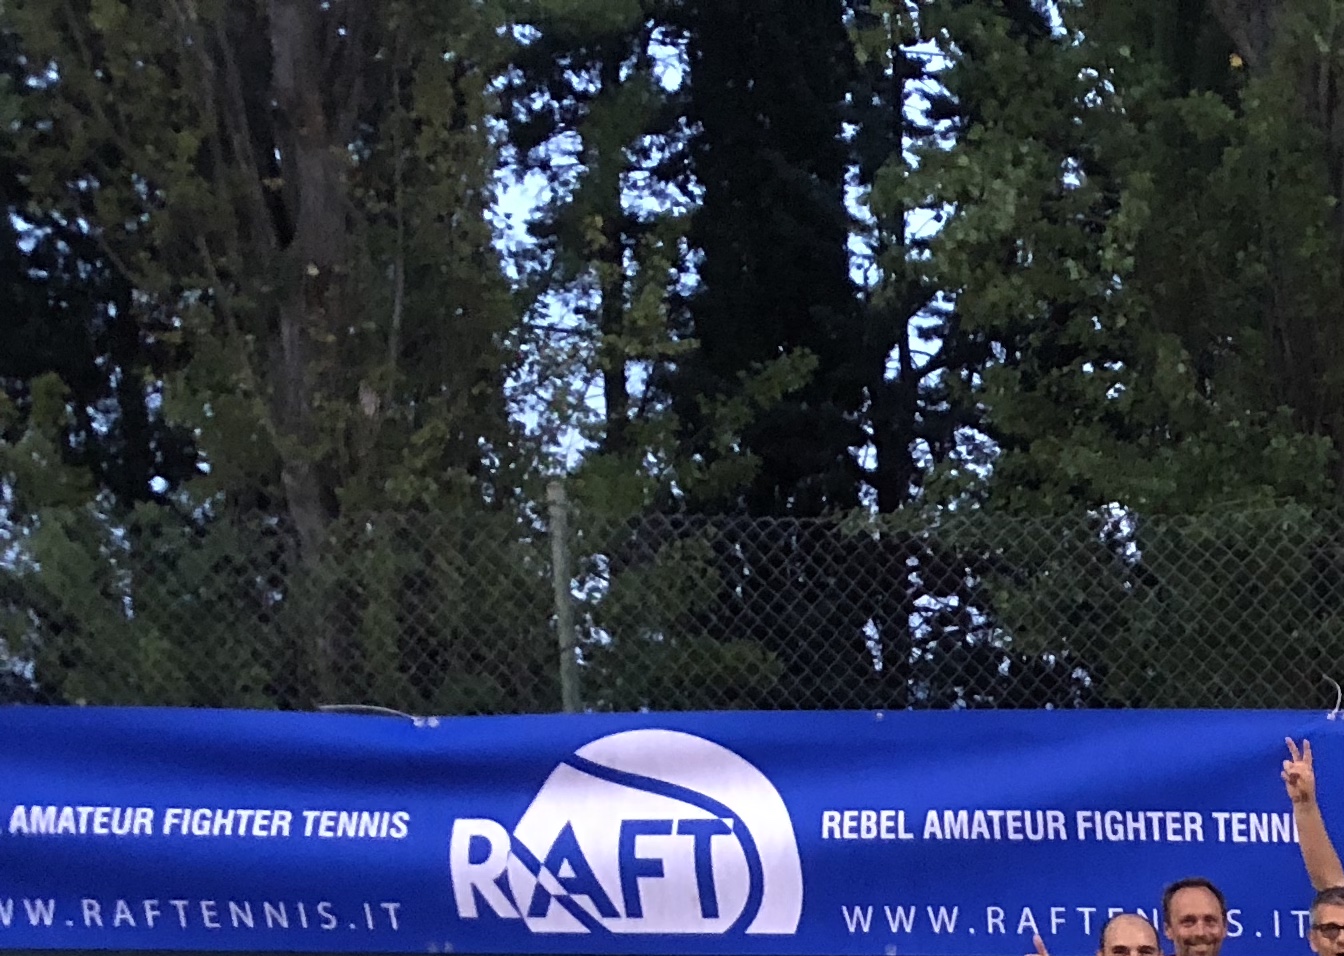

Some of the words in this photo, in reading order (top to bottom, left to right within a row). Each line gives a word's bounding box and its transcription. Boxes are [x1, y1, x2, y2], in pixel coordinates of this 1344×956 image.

[8, 805, 154, 836] AMATEUR
[163, 808, 292, 837] FIGHTER
[303, 811, 411, 839] TENNIS
[821, 809, 914, 840] REBEL
[923, 810, 1068, 841] AMATEUR
[1076, 811, 1204, 842] FIGHTER
[1212, 812, 1300, 843] TENNI
